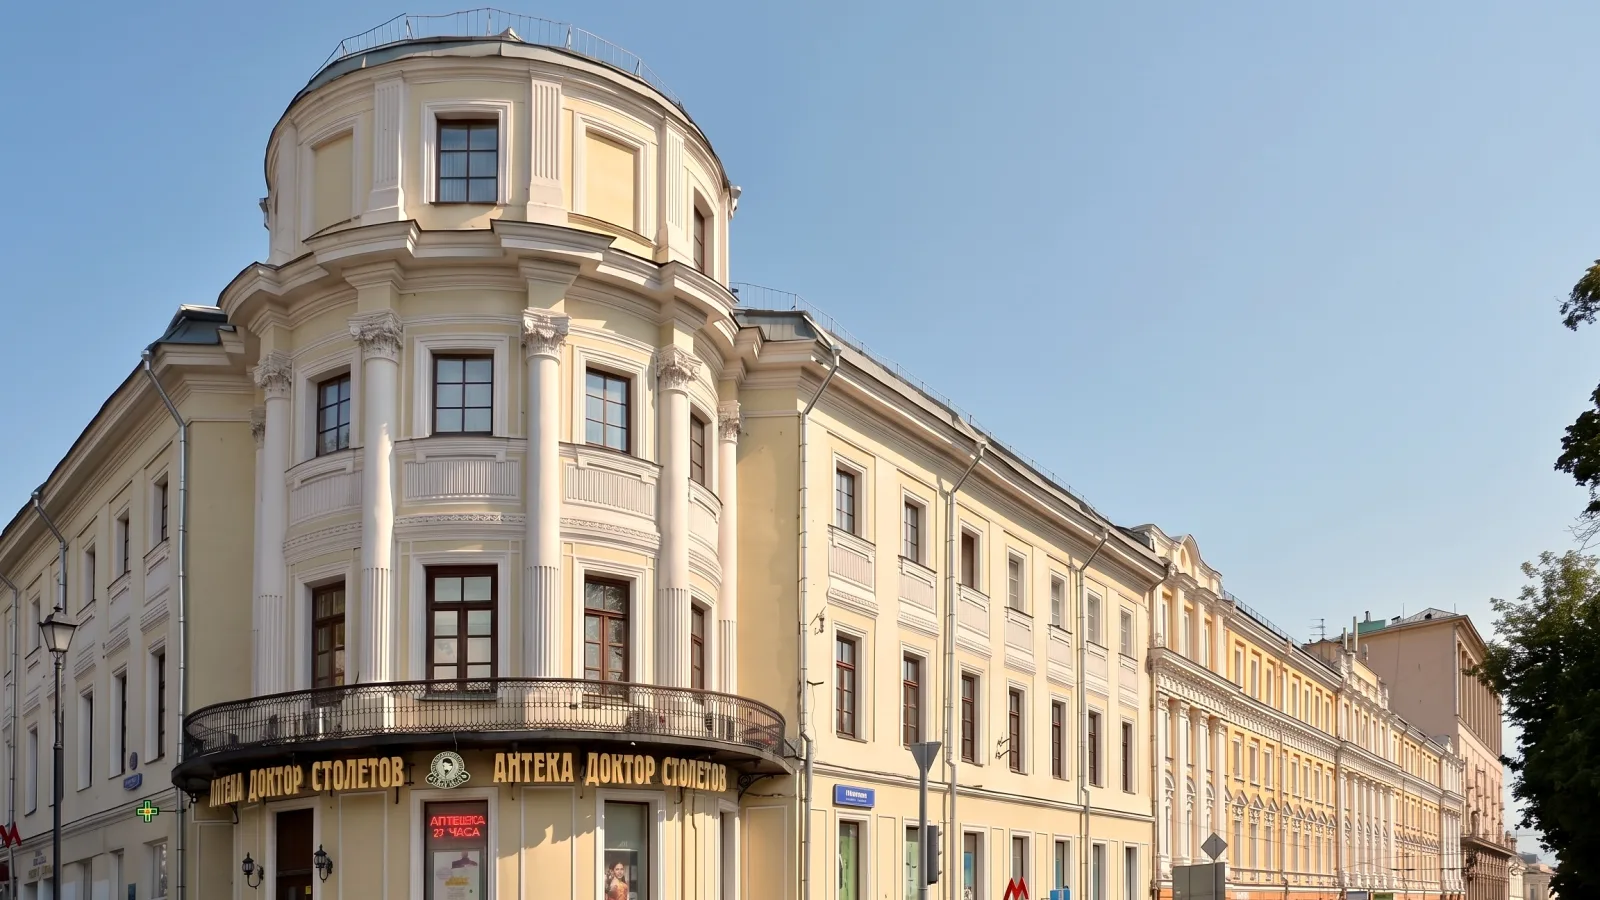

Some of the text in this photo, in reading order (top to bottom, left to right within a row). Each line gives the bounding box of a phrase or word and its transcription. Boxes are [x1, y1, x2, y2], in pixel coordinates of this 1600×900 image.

[248, 765, 303, 803] ДОКТОР
[312, 757, 405, 791] СТОЛЕТОВ
[585, 752, 655, 786] ДОКТОР
[661, 757, 727, 792] СТОЛЕТОВ
